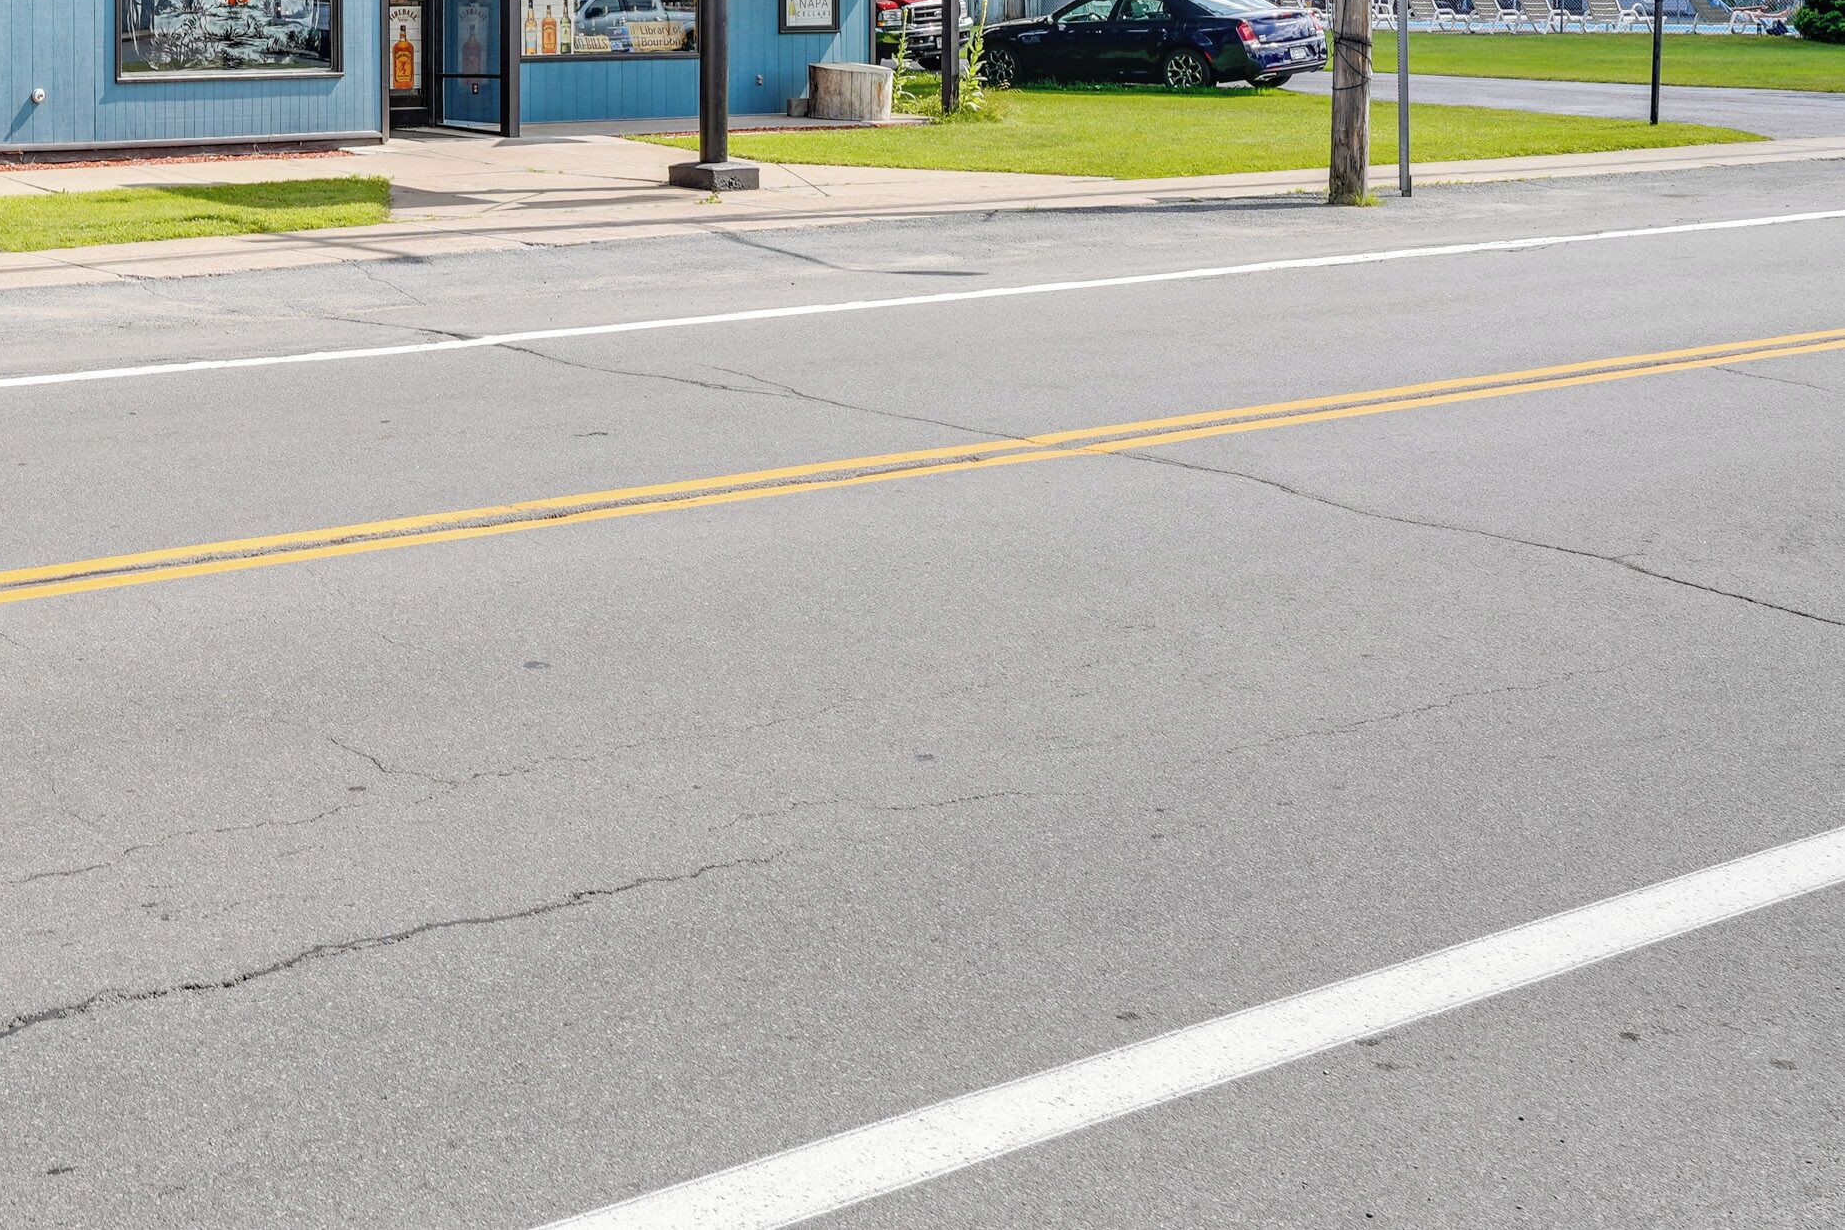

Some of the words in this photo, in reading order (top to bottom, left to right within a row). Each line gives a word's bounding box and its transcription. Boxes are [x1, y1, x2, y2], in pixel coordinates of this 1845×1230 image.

[390, 8, 417, 22] FIREBALL
[640, 25, 672, 36] Library
[641, 37, 686, 47] Bourbons
